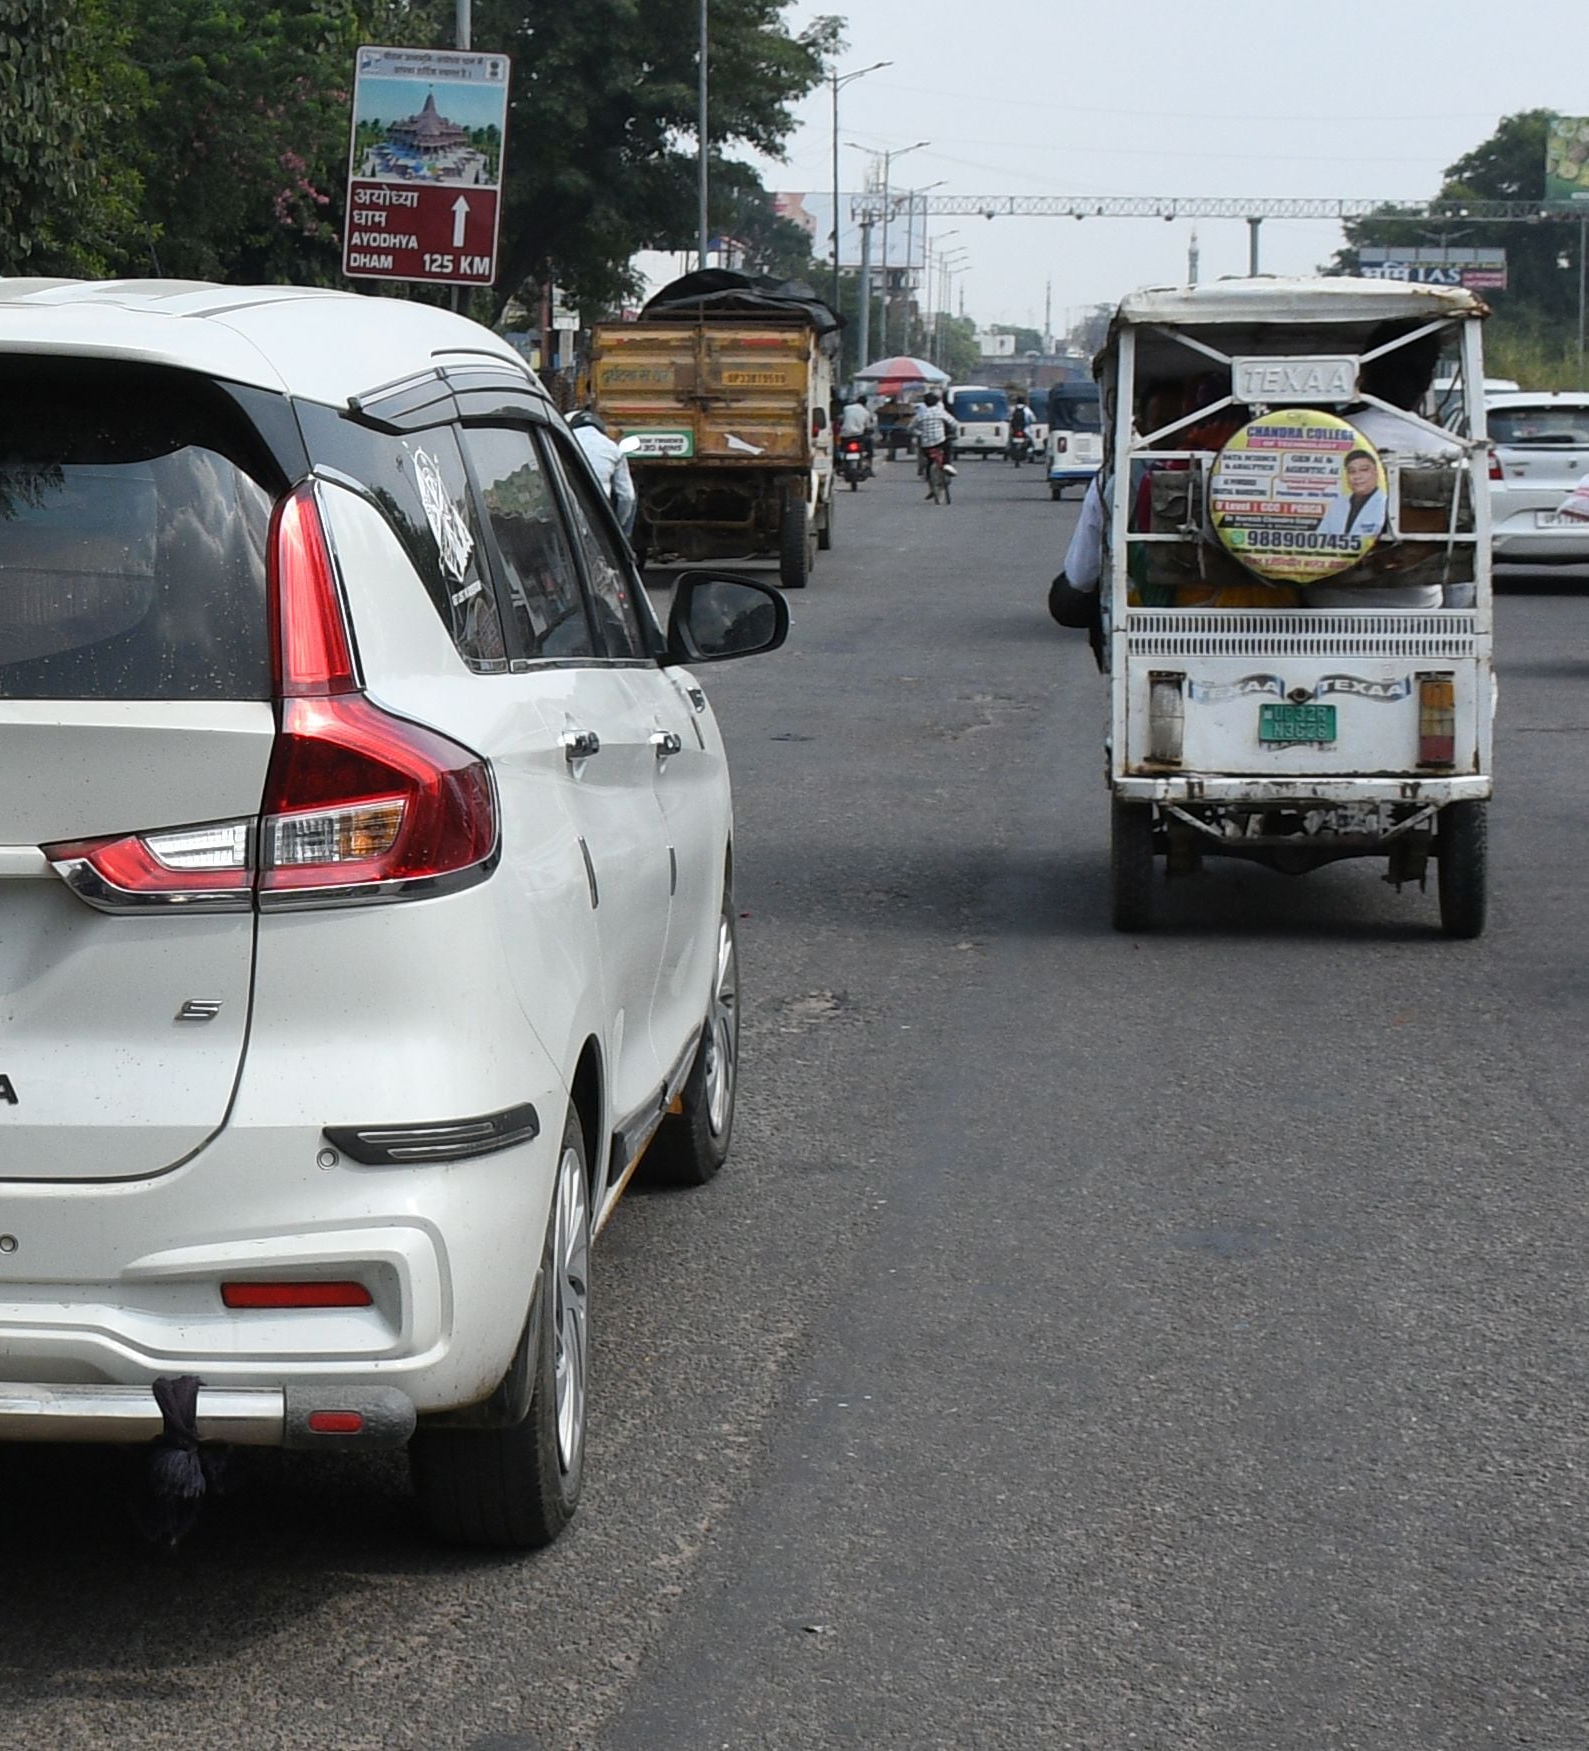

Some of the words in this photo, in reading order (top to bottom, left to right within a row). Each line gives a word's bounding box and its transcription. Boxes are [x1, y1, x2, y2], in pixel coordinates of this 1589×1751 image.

[354, 184, 419, 208] अयोध्या
[353, 210, 387, 227] धाम
[351, 231, 419, 249] AYODHYA
[350, 253, 393, 269] DHAM
[423, 253, 454, 273] 125
[460, 256, 491, 276] KM
[1244, 367, 1348, 394] TEXAA
[1247, 426, 1303, 439] CHANDRA
[1248, 531, 1361, 551] 9889007455
[1199, 680, 1281, 698] TEXAA
[1319, 679, 1405, 696] TEXAA
[1274, 706, 1327, 721] UP32R
